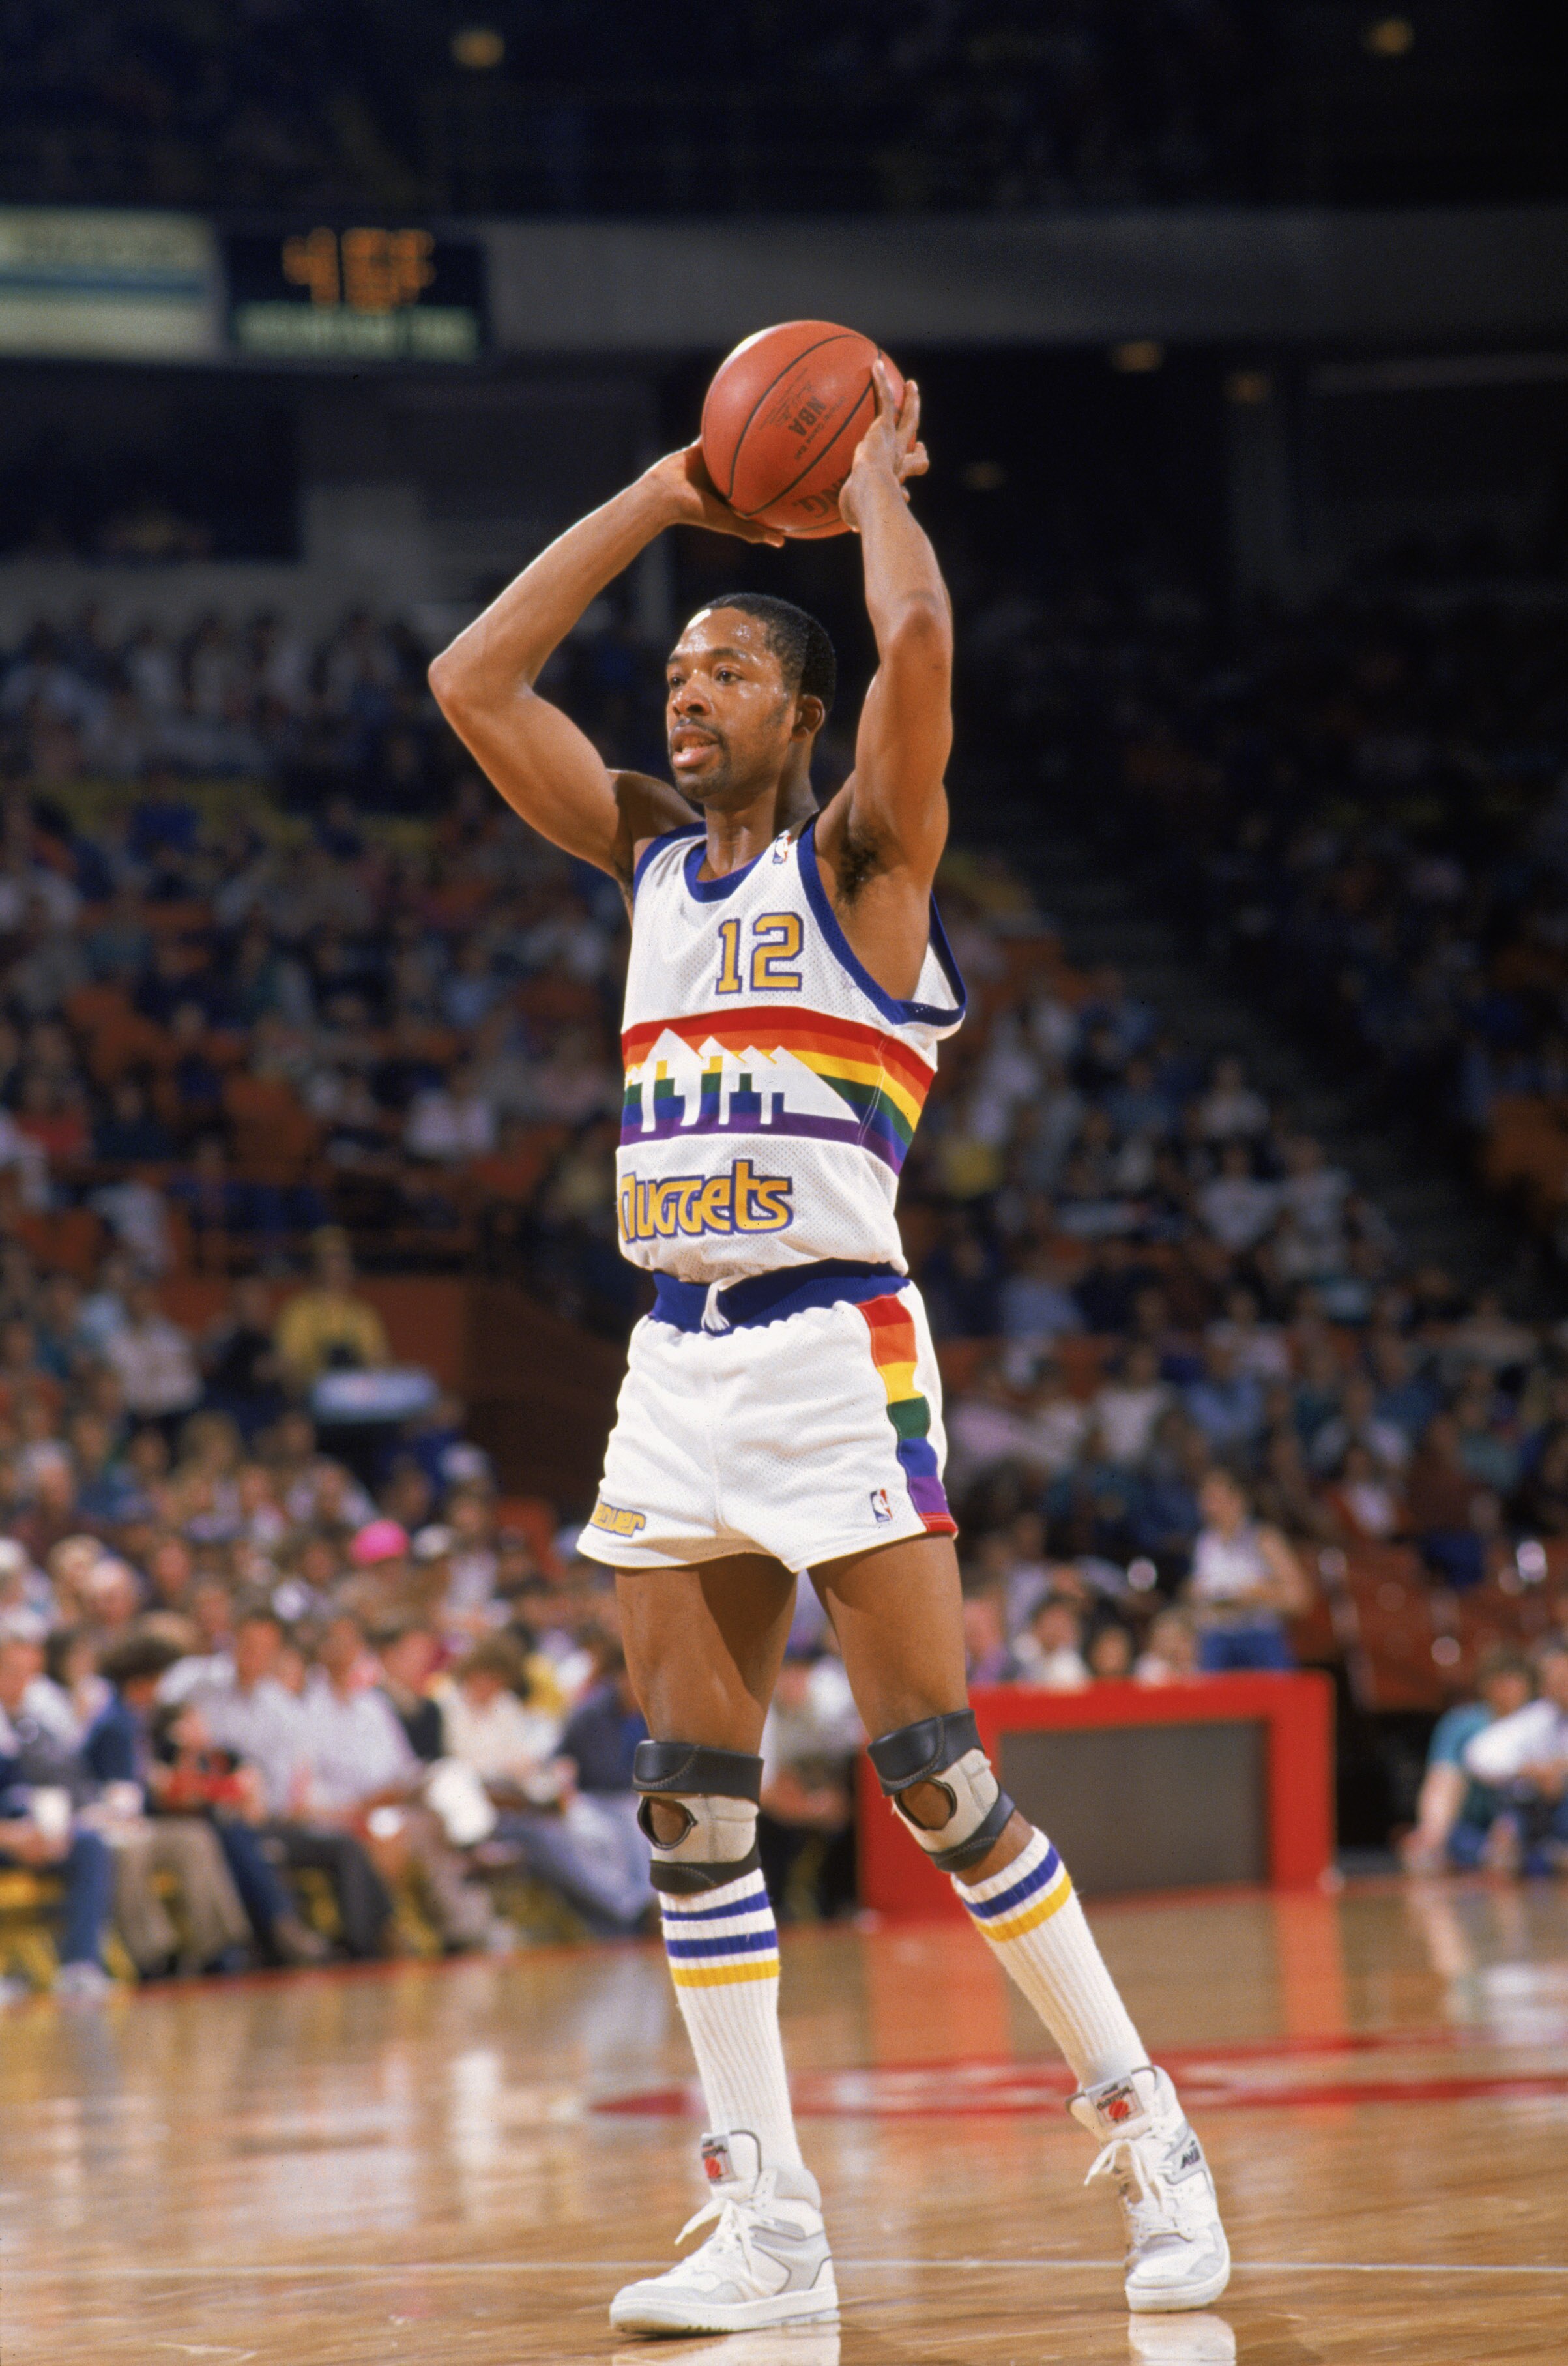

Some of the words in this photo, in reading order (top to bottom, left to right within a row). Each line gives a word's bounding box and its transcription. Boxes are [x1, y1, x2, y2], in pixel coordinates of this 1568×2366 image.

[788, 396, 826, 437] NBA
[715, 911, 804, 995] 12
[617, 1158, 794, 1244] Nuggets
